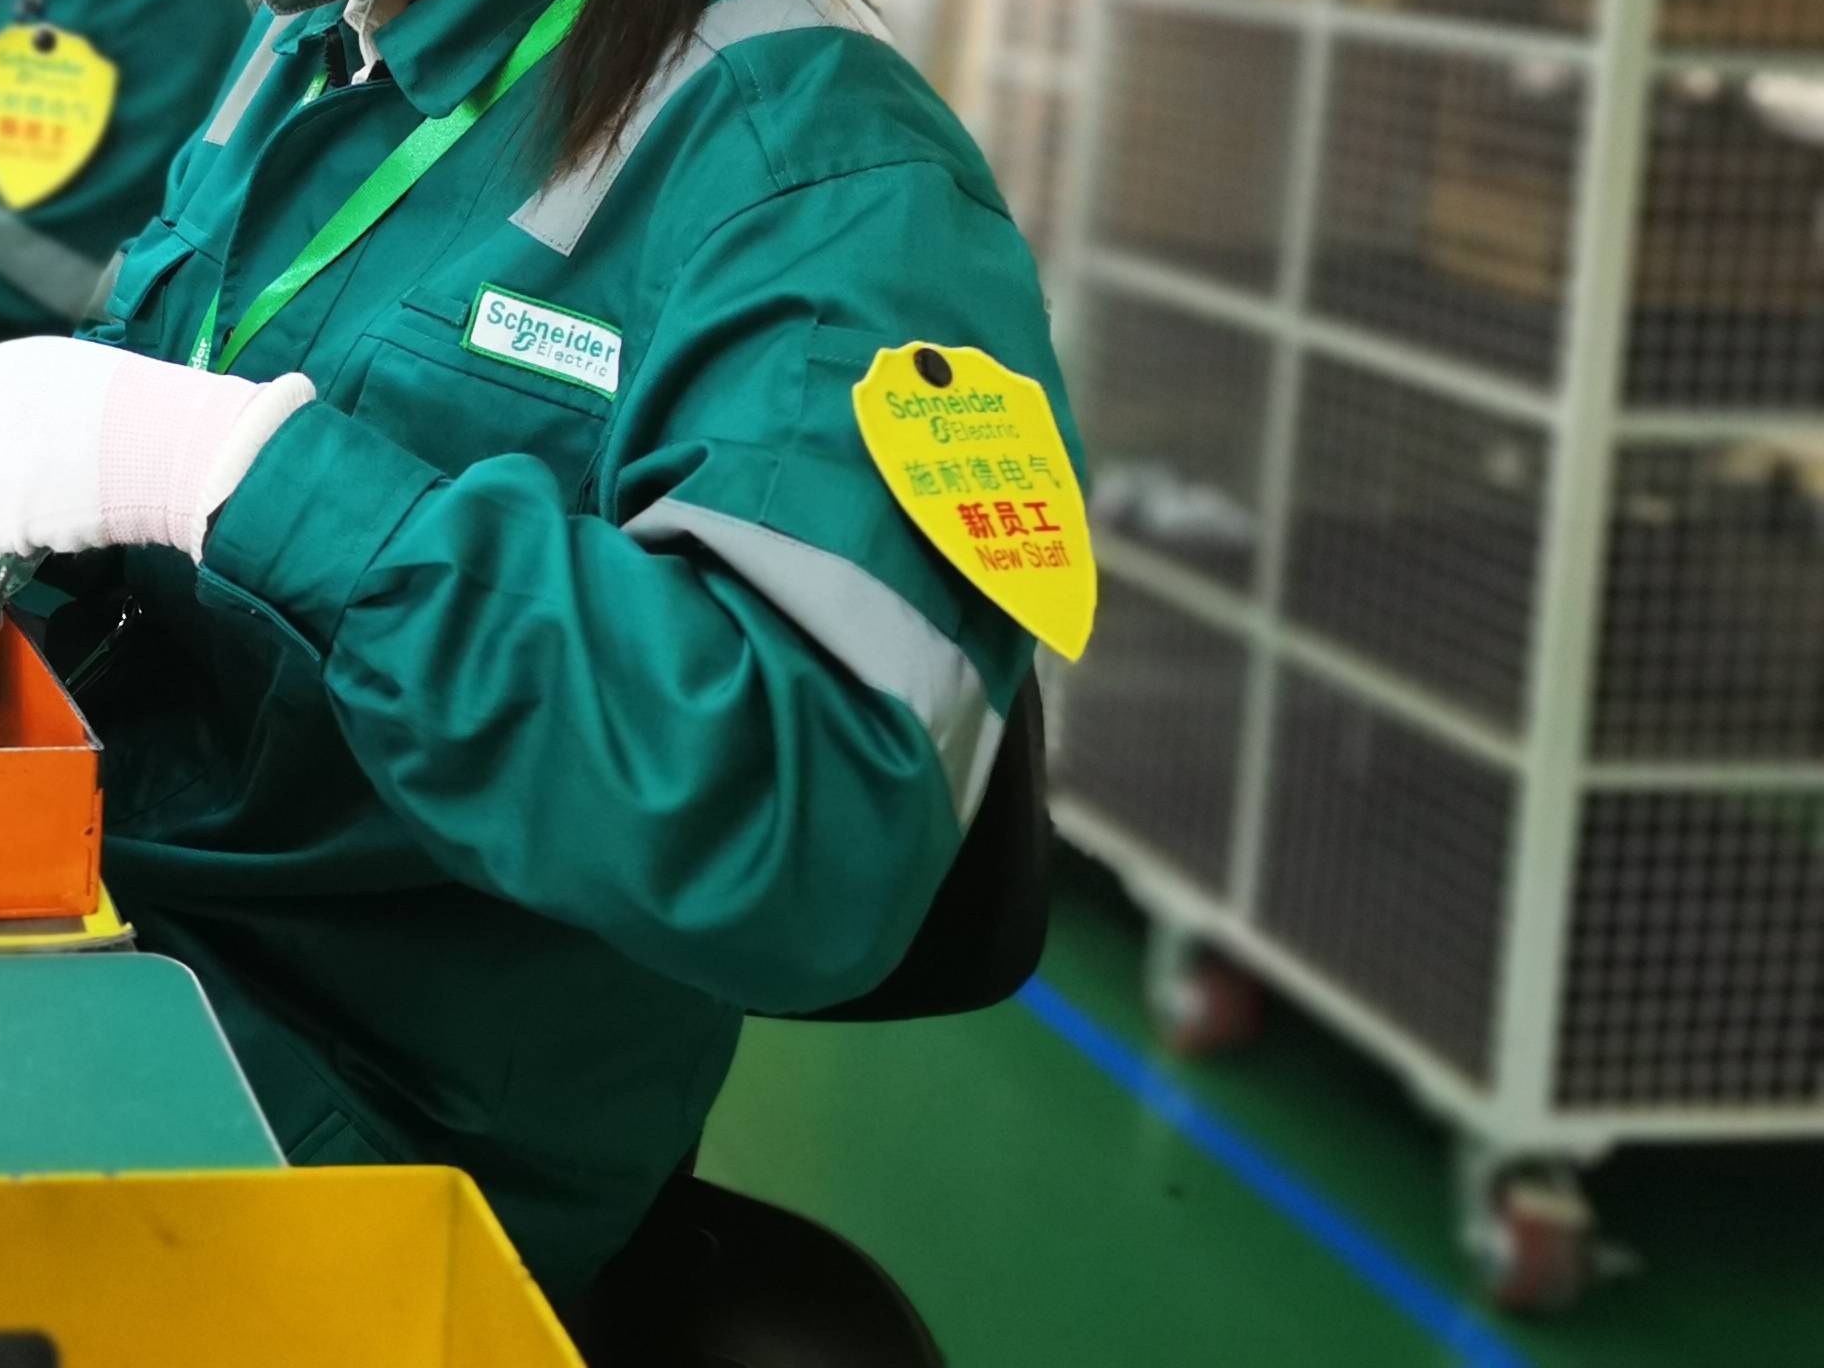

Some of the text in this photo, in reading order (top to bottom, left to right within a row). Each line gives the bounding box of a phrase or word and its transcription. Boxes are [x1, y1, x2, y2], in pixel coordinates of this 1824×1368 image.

[487, 301, 615, 362] Schneider
[537, 342, 608, 377] Electric
[885, 389, 1006, 419] Schneider
[951, 419, 1020, 441] Electric
[903, 454, 1061, 496] 施耐德电气
[957, 501, 1061, 538] 新员工
[975, 540, 1071, 571] New Staff
